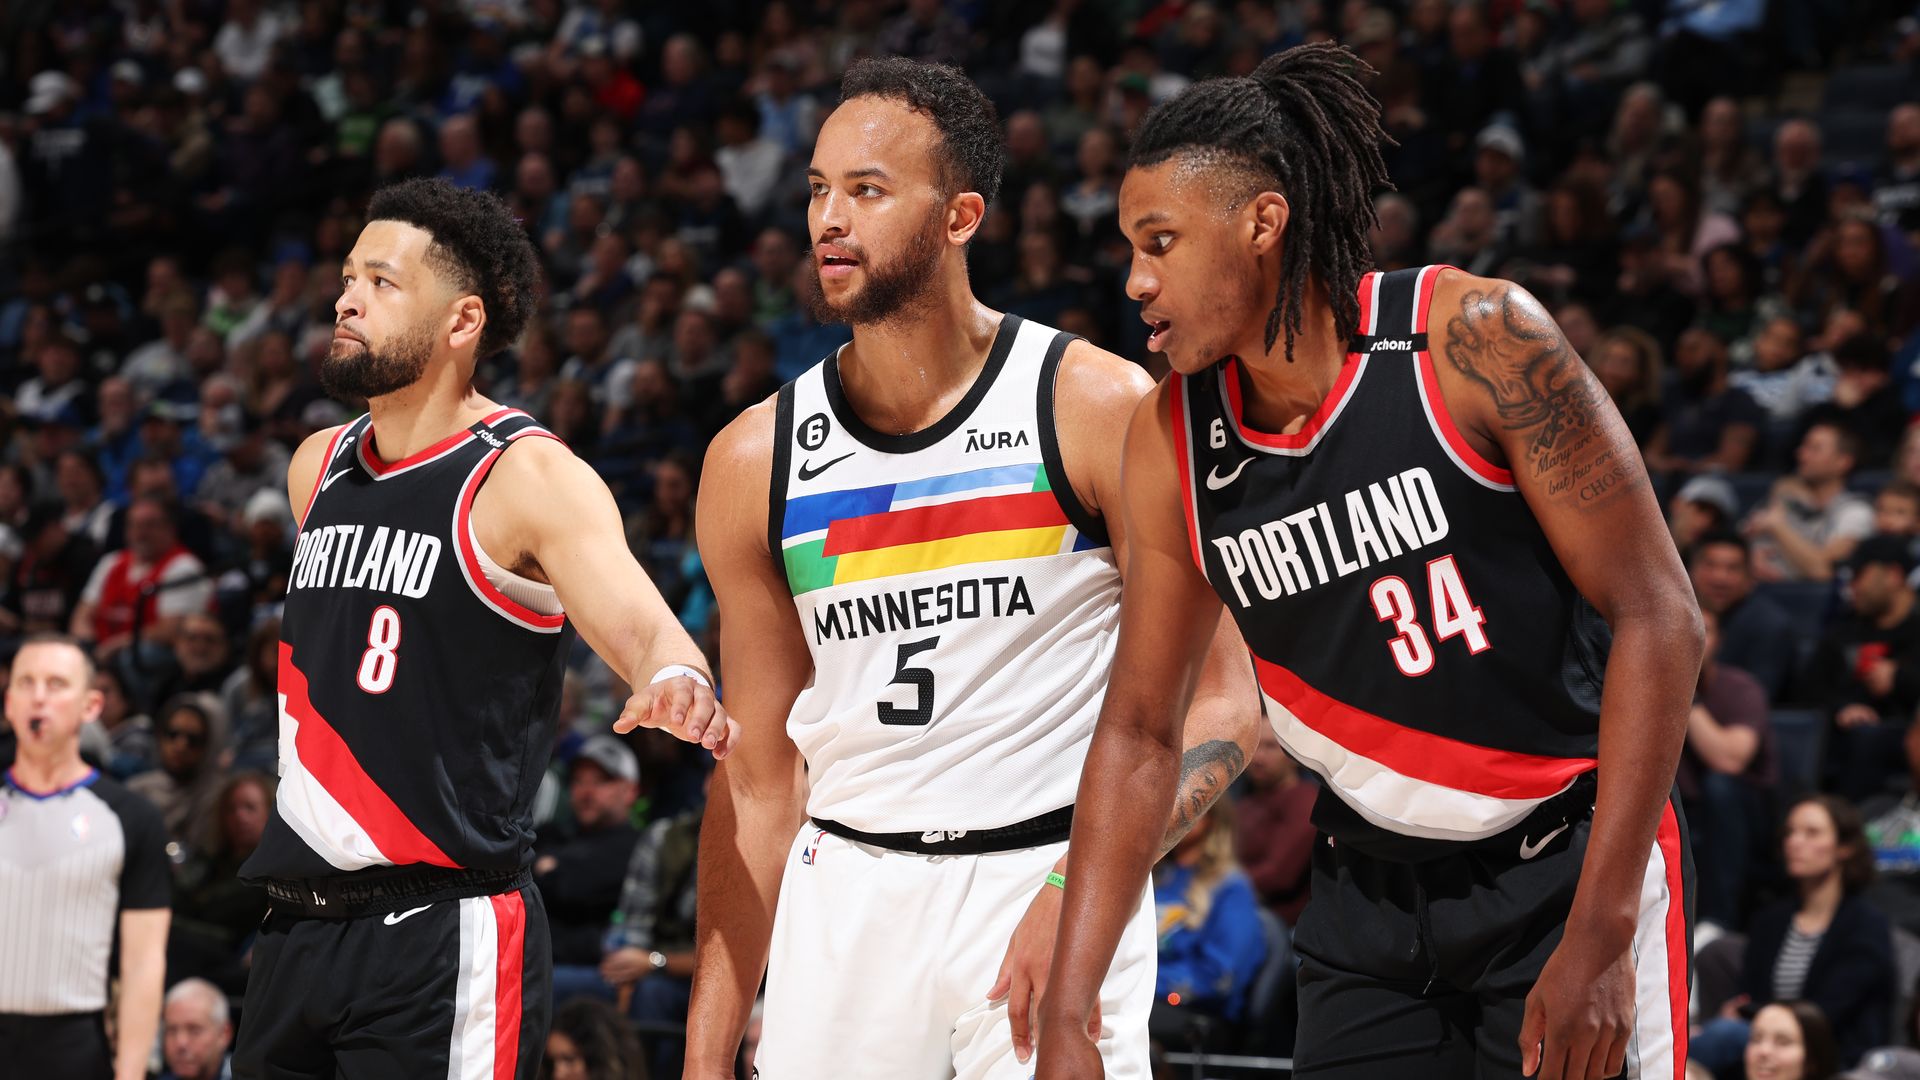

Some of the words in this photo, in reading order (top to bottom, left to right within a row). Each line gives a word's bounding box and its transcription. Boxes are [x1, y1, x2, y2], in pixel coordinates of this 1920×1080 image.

[1370, 337, 1412, 351] schonz
[803, 416, 826, 448] 6
[1209, 417, 1227, 449] 6
[1534, 447, 1573, 477] Many
[1574, 434, 1592, 451] are
[1549, 476, 1568, 495] but
[1567, 463, 1592, 491] few
[1595, 450, 1614, 466] are
[287, 525, 442, 599] PORTLAND
[1211, 467, 1449, 608] PORTLAND
[814, 576, 1035, 645] MINNESOTA
[1369, 554, 1491, 678] 34
[356, 604, 402, 694] 8
[877, 635, 941, 726] 5
